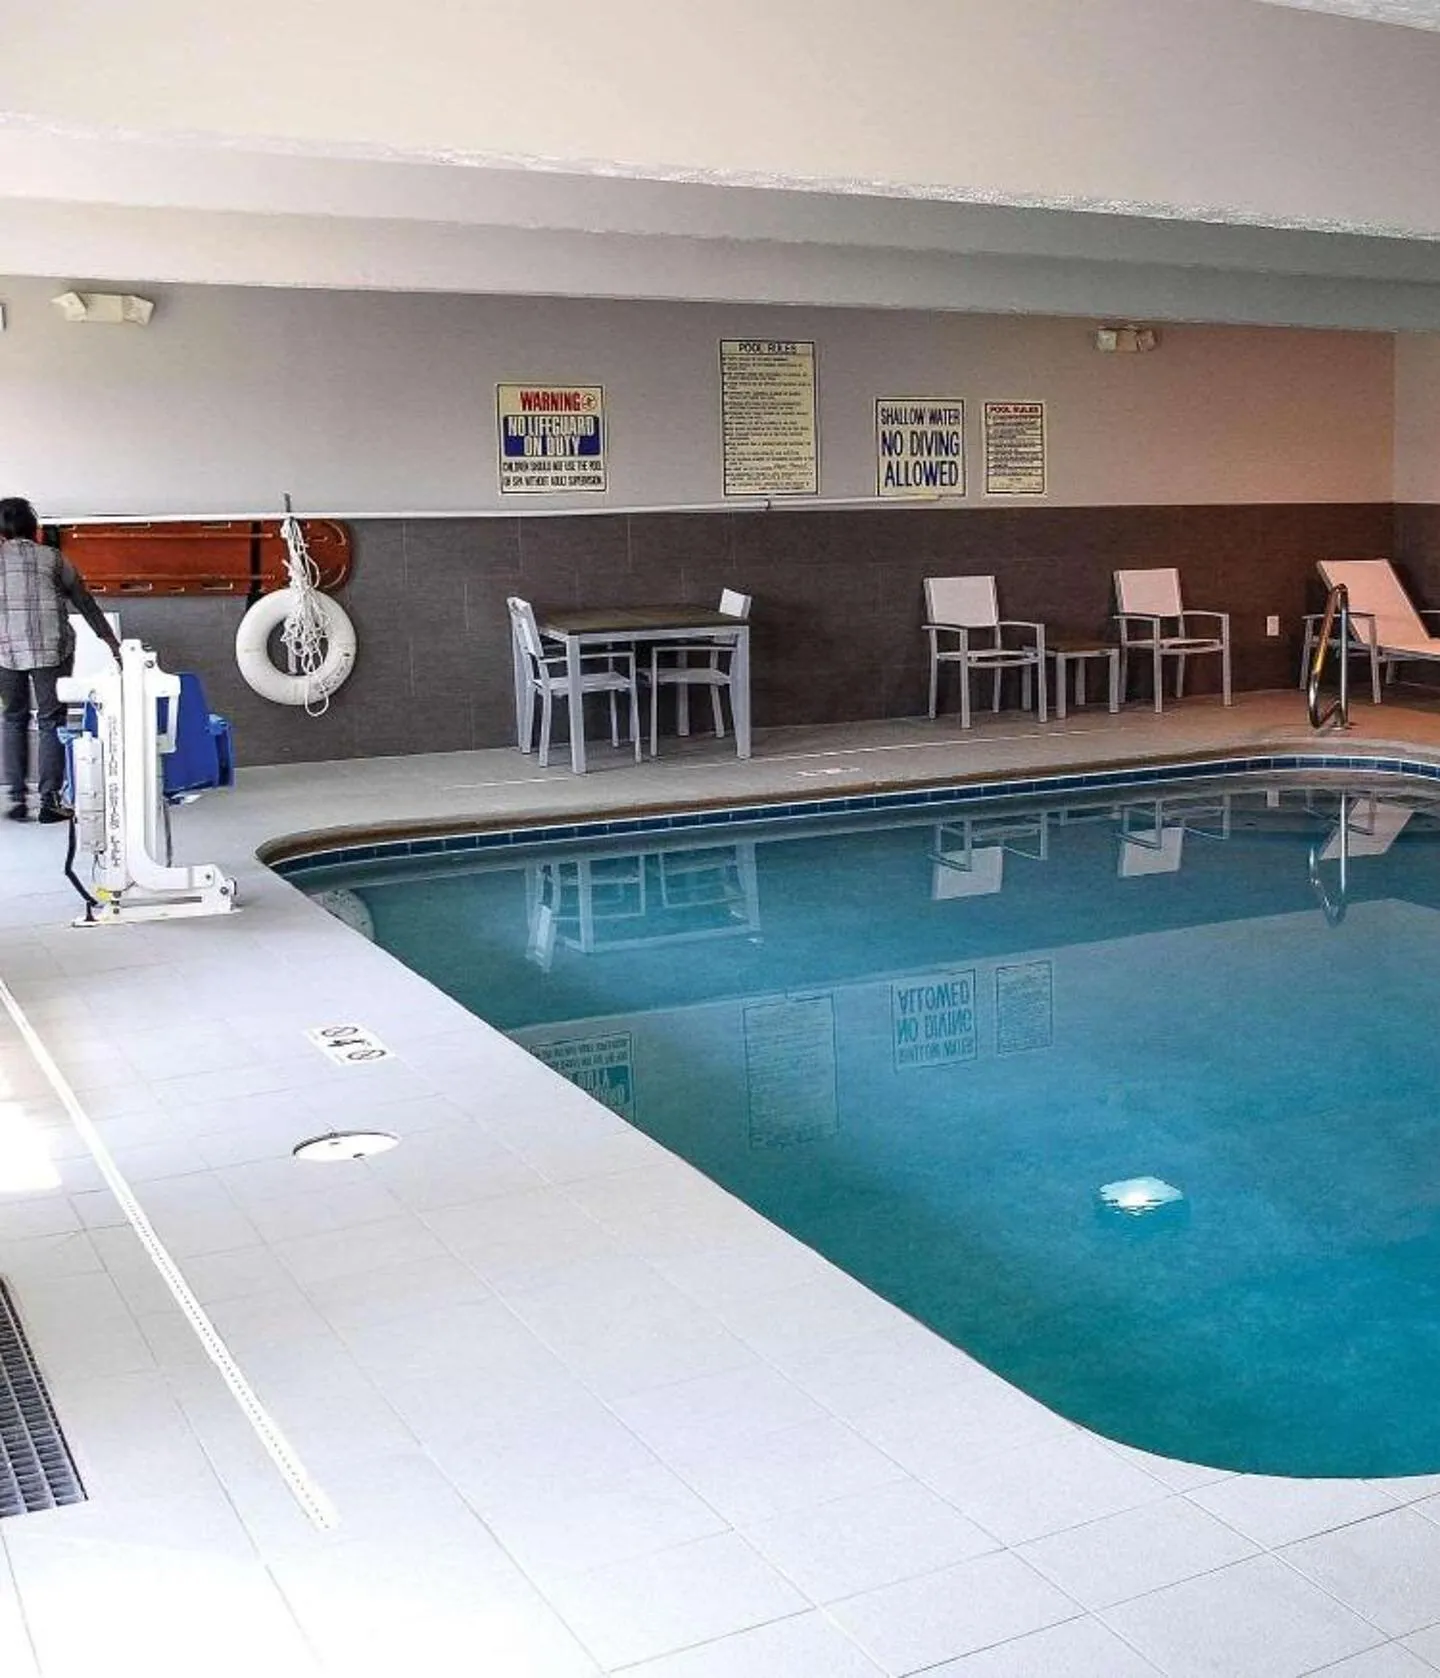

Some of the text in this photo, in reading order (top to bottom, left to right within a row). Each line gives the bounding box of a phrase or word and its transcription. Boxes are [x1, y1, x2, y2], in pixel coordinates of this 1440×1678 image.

[738, 343, 797, 353] POOL RULES
[519, 391, 582, 411] WARNING
[880, 406, 960, 425] SHALLOW WATER
[507, 416, 594, 436] NO LIFEGUARD
[523, 436, 580, 457] ON DUTY
[881, 430, 960, 457] NO DIVING
[884, 460, 959, 487] ALLOWED
